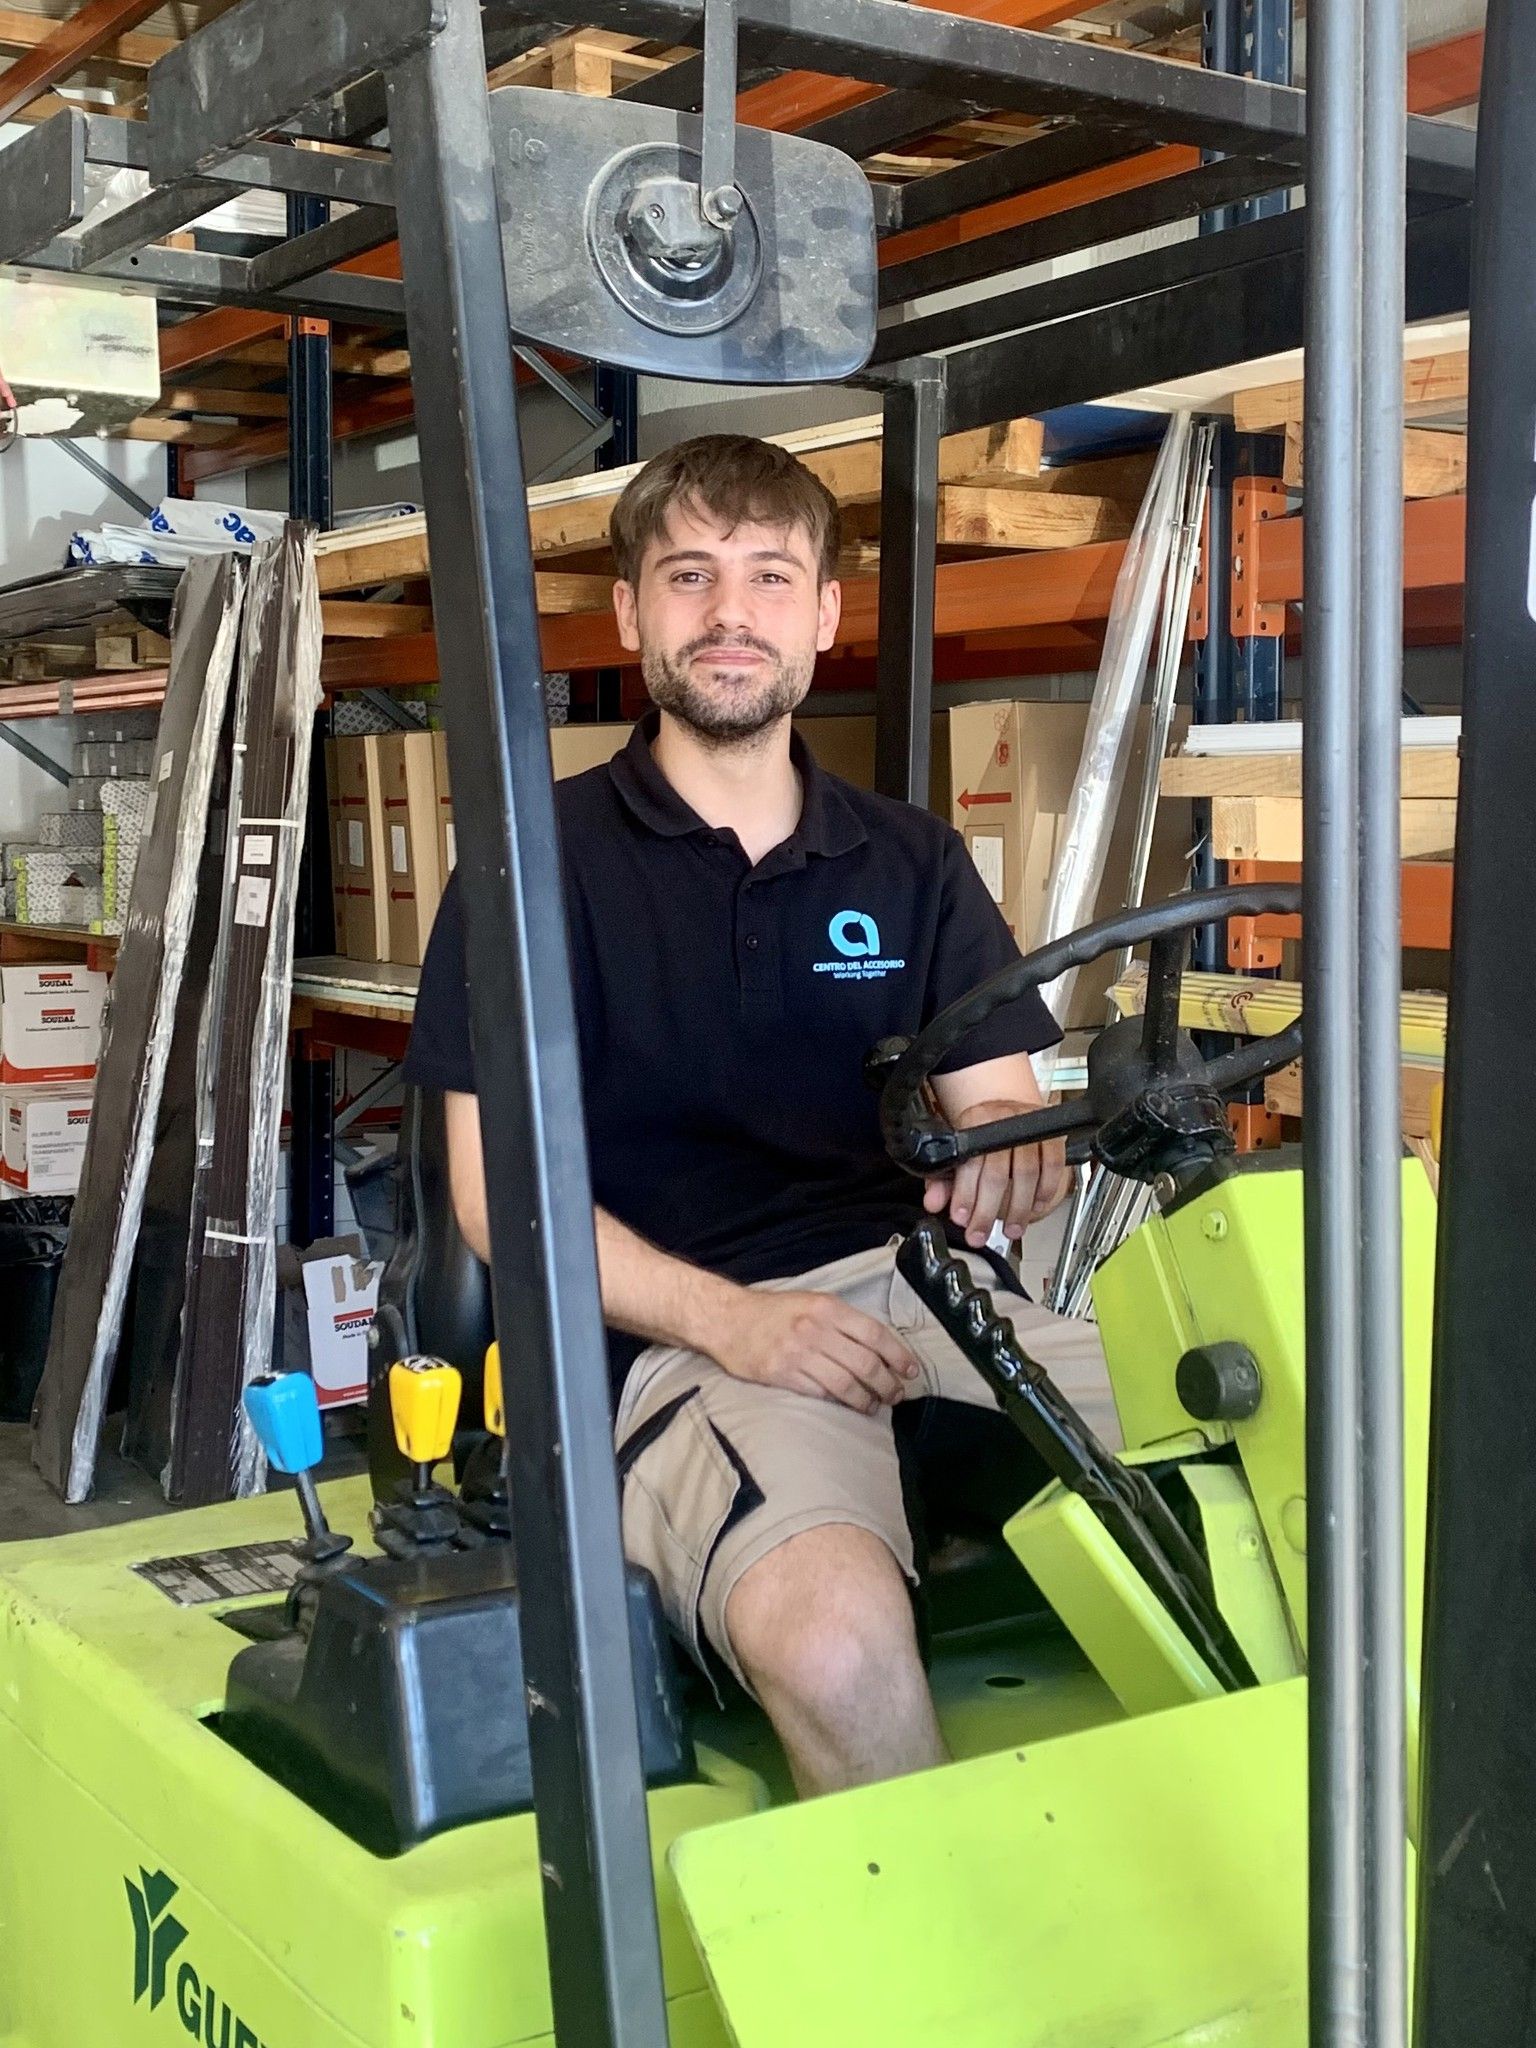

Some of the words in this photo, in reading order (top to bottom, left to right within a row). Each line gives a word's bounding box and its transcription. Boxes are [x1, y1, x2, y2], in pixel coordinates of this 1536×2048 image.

[813, 962, 847, 972] CENTRO
[847, 961, 862, 971] DEL
[863, 959, 905, 969] ACCESORIO
[833, 971, 861, 980] Working
[862, 970, 887, 979] Together
[39, 980, 73, 988] SOUDAL
[41, 1016, 75, 1024] SOUDAL
